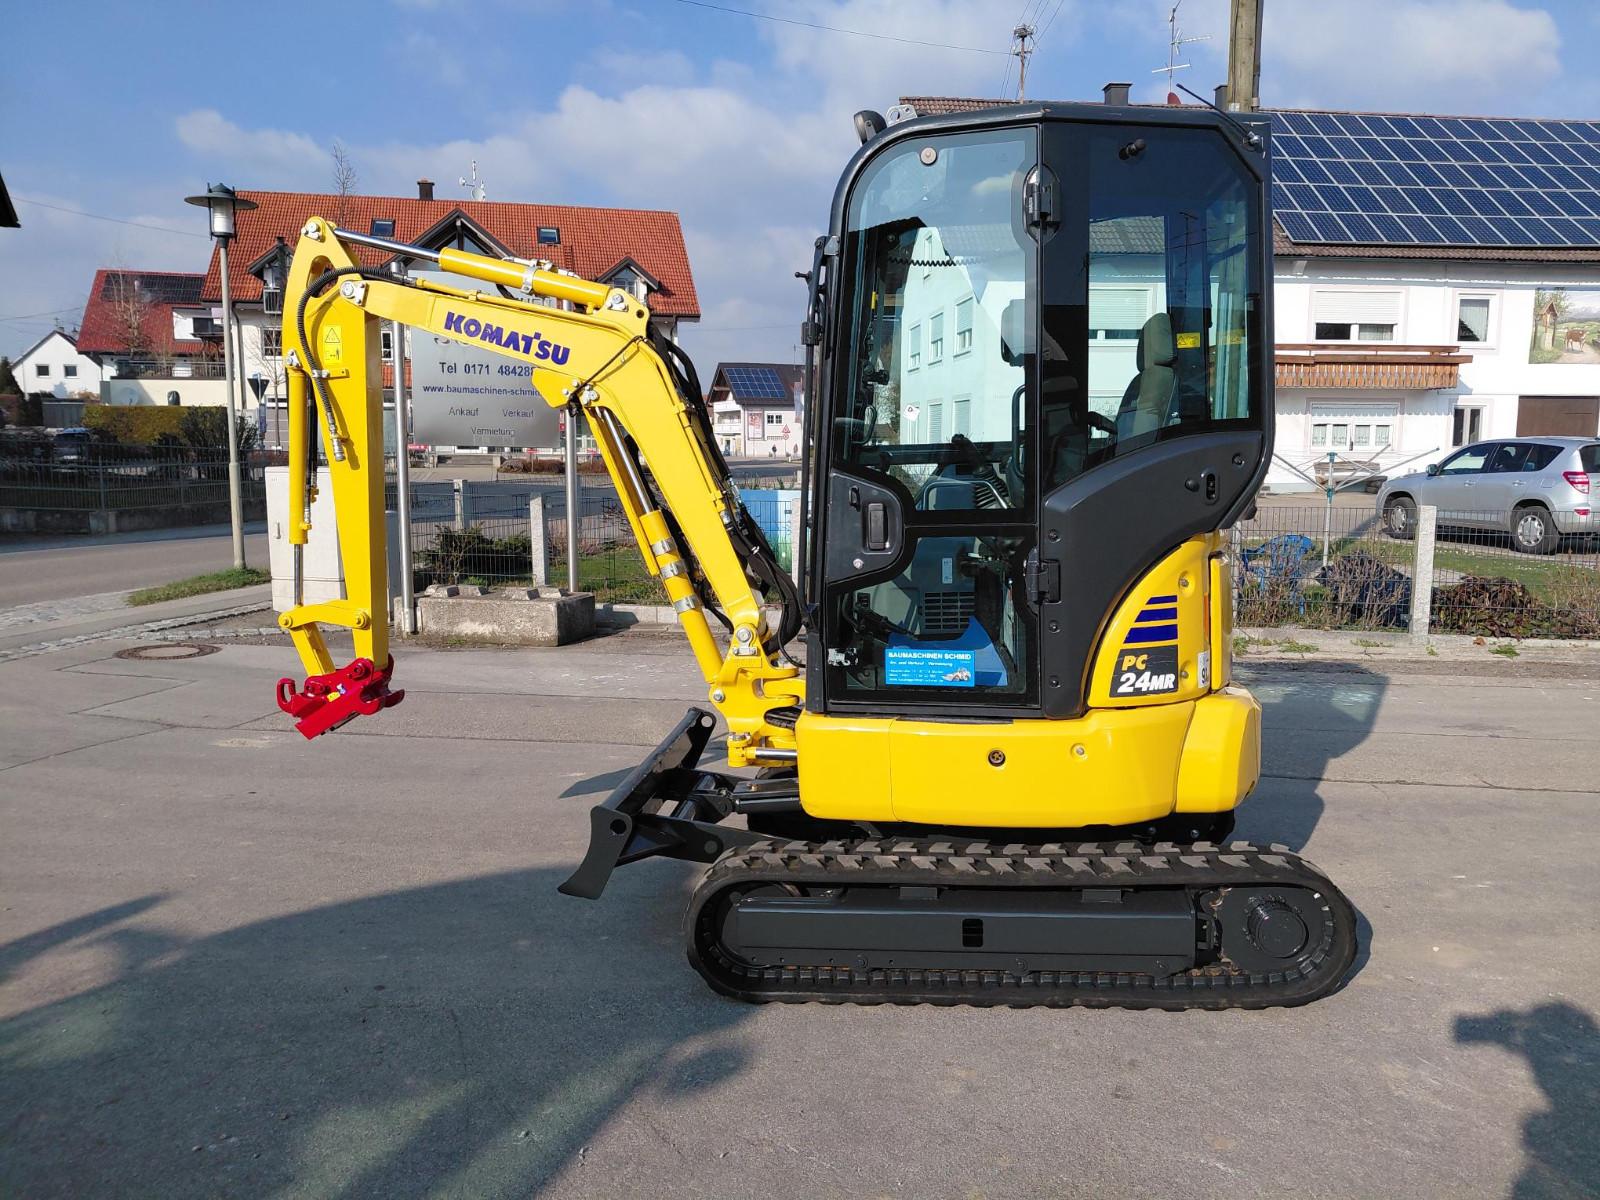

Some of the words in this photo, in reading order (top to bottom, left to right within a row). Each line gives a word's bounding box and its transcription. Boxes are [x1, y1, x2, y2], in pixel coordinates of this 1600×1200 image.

[444, 311, 571, 366] KOMATSU
[439, 362, 457, 375] Tel
[464, 363, 490, 375] 0171
[448, 406, 480, 417] Ankauf
[502, 408, 535, 418] Verkauf
[471, 426, 516, 438] Vermietung
[888, 652, 943, 660] BAUMASCHINEN
[944, 653, 972, 661] SCHMID
[1121, 654, 1149, 671] PC
[1117, 671, 1176, 693] 24MR
